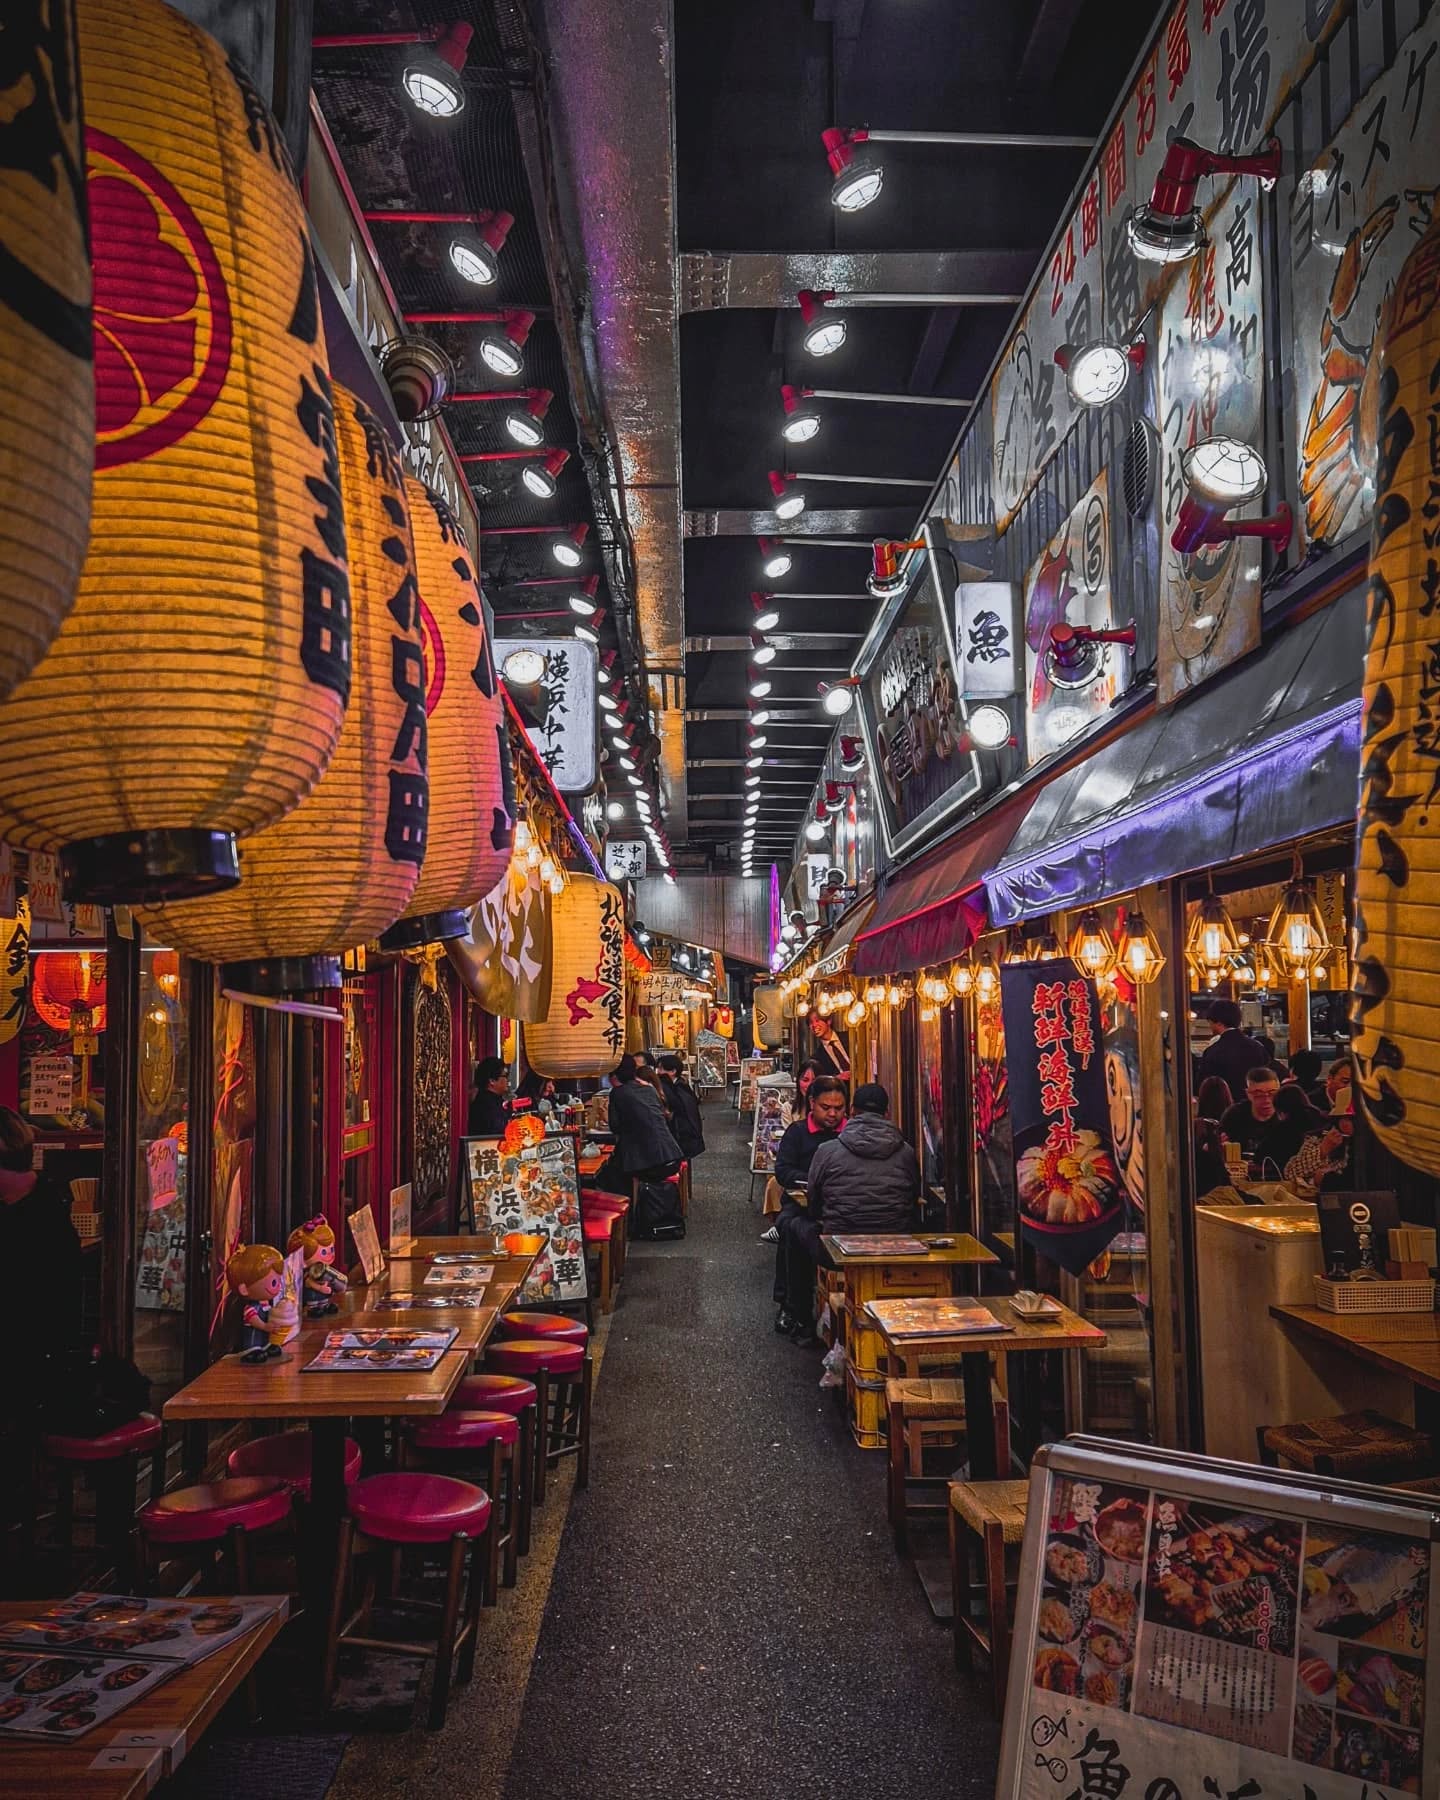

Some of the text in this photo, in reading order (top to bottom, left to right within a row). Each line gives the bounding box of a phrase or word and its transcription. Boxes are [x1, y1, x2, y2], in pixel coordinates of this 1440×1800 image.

[966, 610, 1010, 664] 魚
[1032, 982, 1080, 1153] 新鮮海鮮丼
